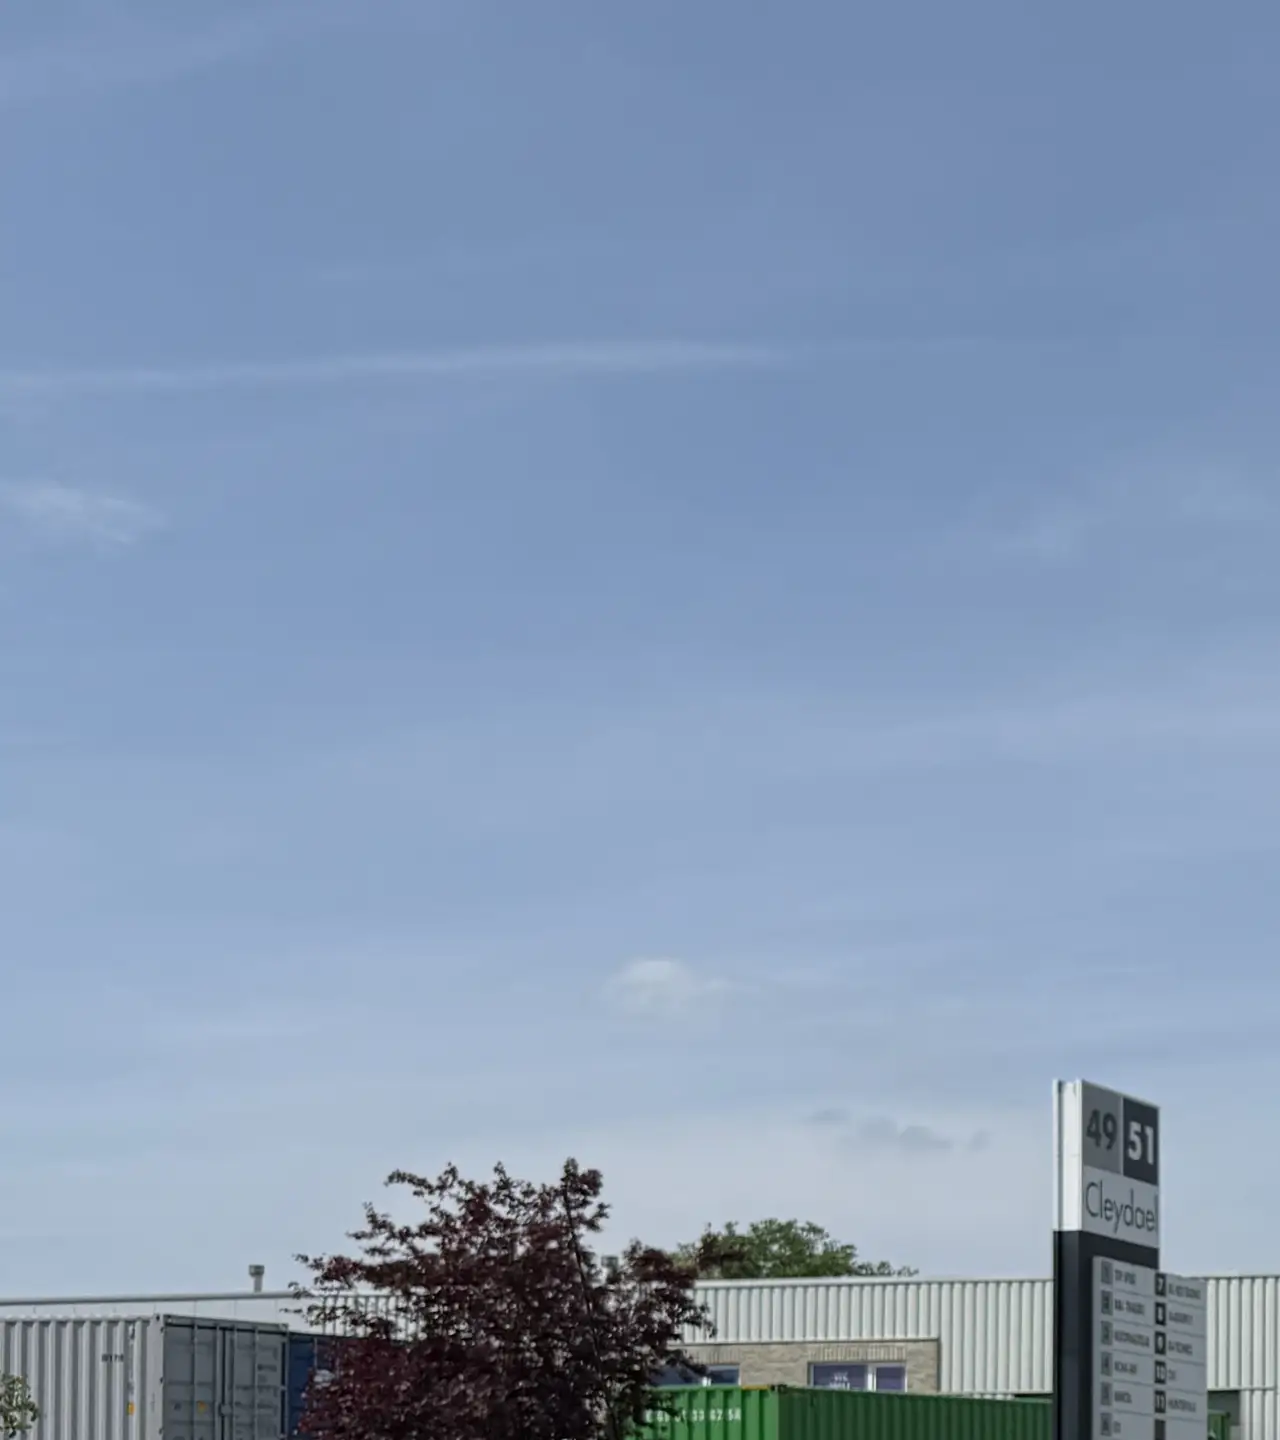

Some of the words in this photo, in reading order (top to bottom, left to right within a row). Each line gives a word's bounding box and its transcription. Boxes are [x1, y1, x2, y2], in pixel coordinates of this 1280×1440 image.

[1086, 1110, 1117, 1150] 49
[1127, 1120, 1155, 1166] 51
[1085, 1180, 1158, 1234] Cleydael
